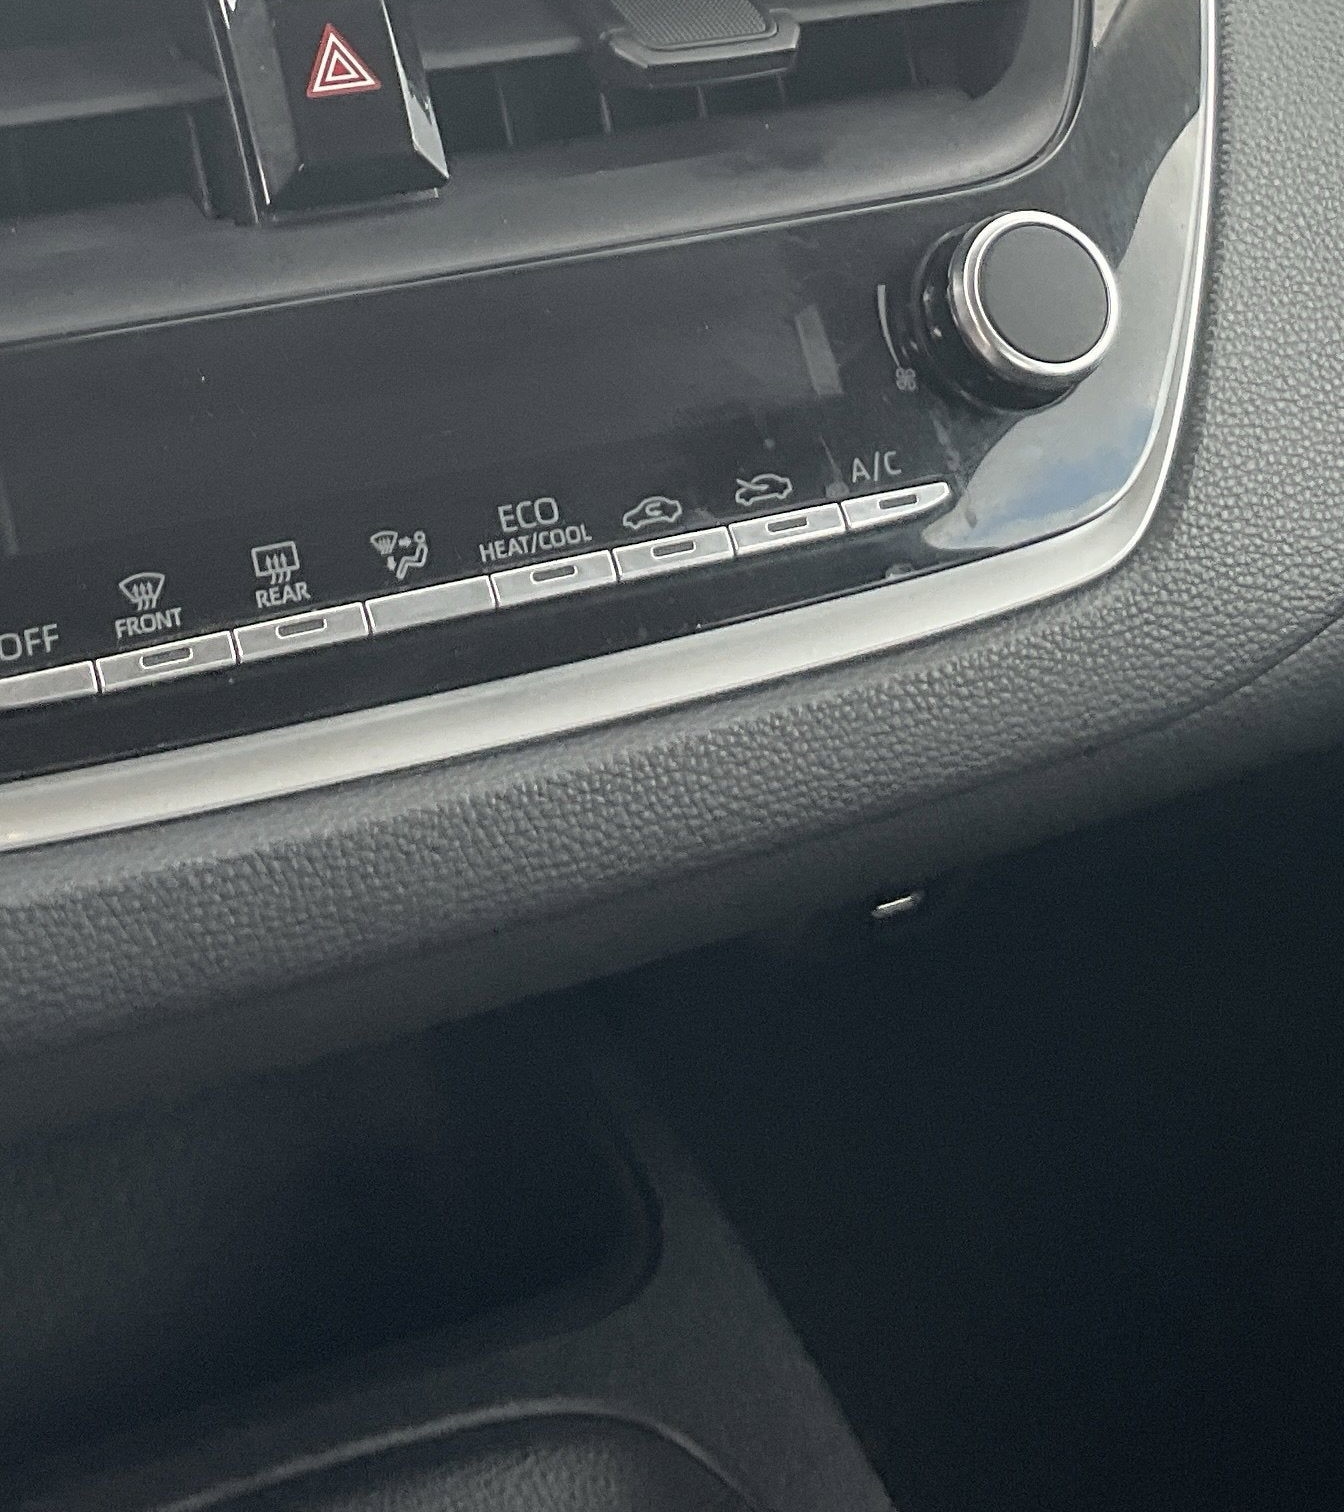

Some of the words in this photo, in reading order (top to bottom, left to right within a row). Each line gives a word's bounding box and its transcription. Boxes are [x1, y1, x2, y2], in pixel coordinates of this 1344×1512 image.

[851, 450, 902, 483] A/C
[498, 496, 559, 534] ECO
[479, 523, 592, 563] HEAT/COOL
[256, 581, 311, 609] REAR
[115, 607, 183, 639] FRONT
